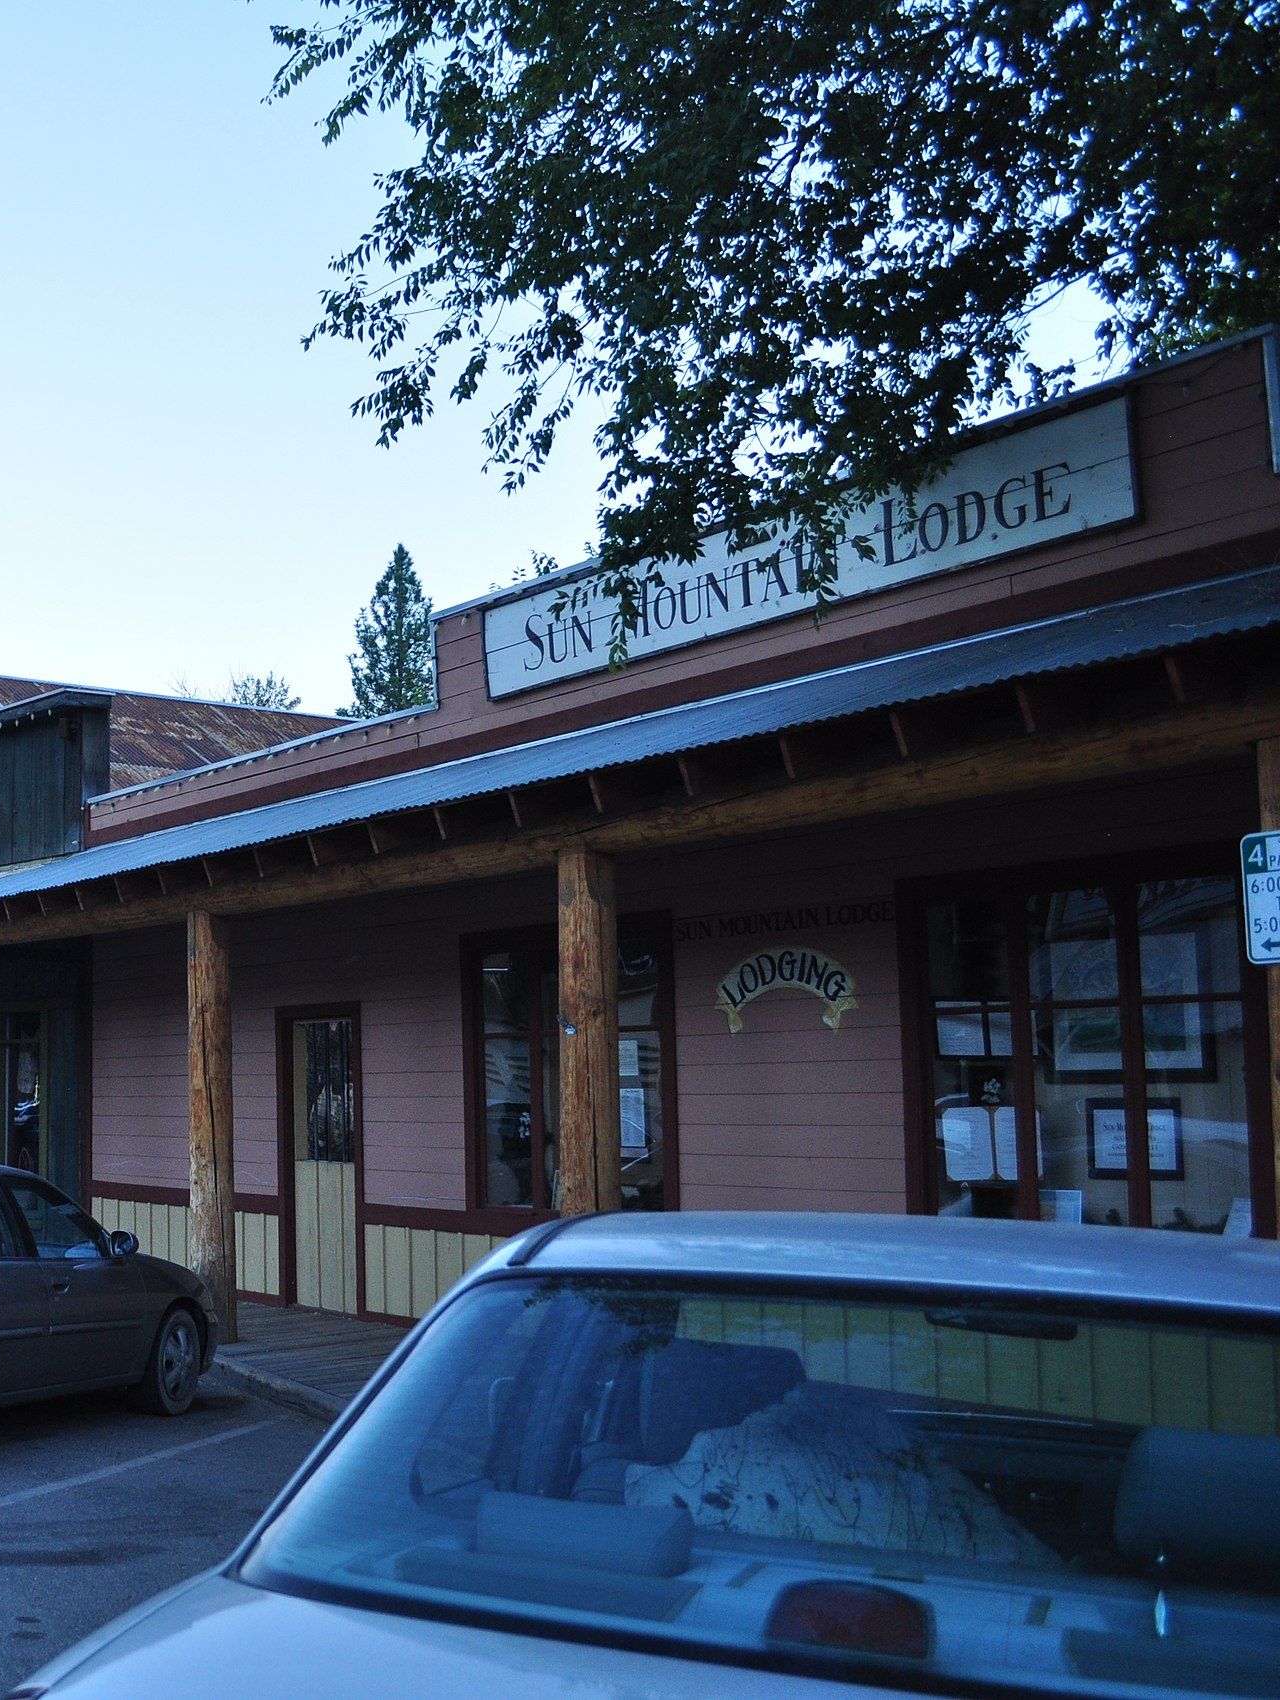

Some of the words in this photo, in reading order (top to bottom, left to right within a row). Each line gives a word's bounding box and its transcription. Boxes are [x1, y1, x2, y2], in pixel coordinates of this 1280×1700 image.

[523, 611, 596, 673] SUN
[877, 461, 1073, 568] LODGE
[1248, 843, 1264, 867] 4
[675, 918, 712, 943] SUN
[719, 906, 819, 939] MOUNTAIN
[826, 900, 895, 926] LODGE
[721, 950, 846, 1008] LODGING
